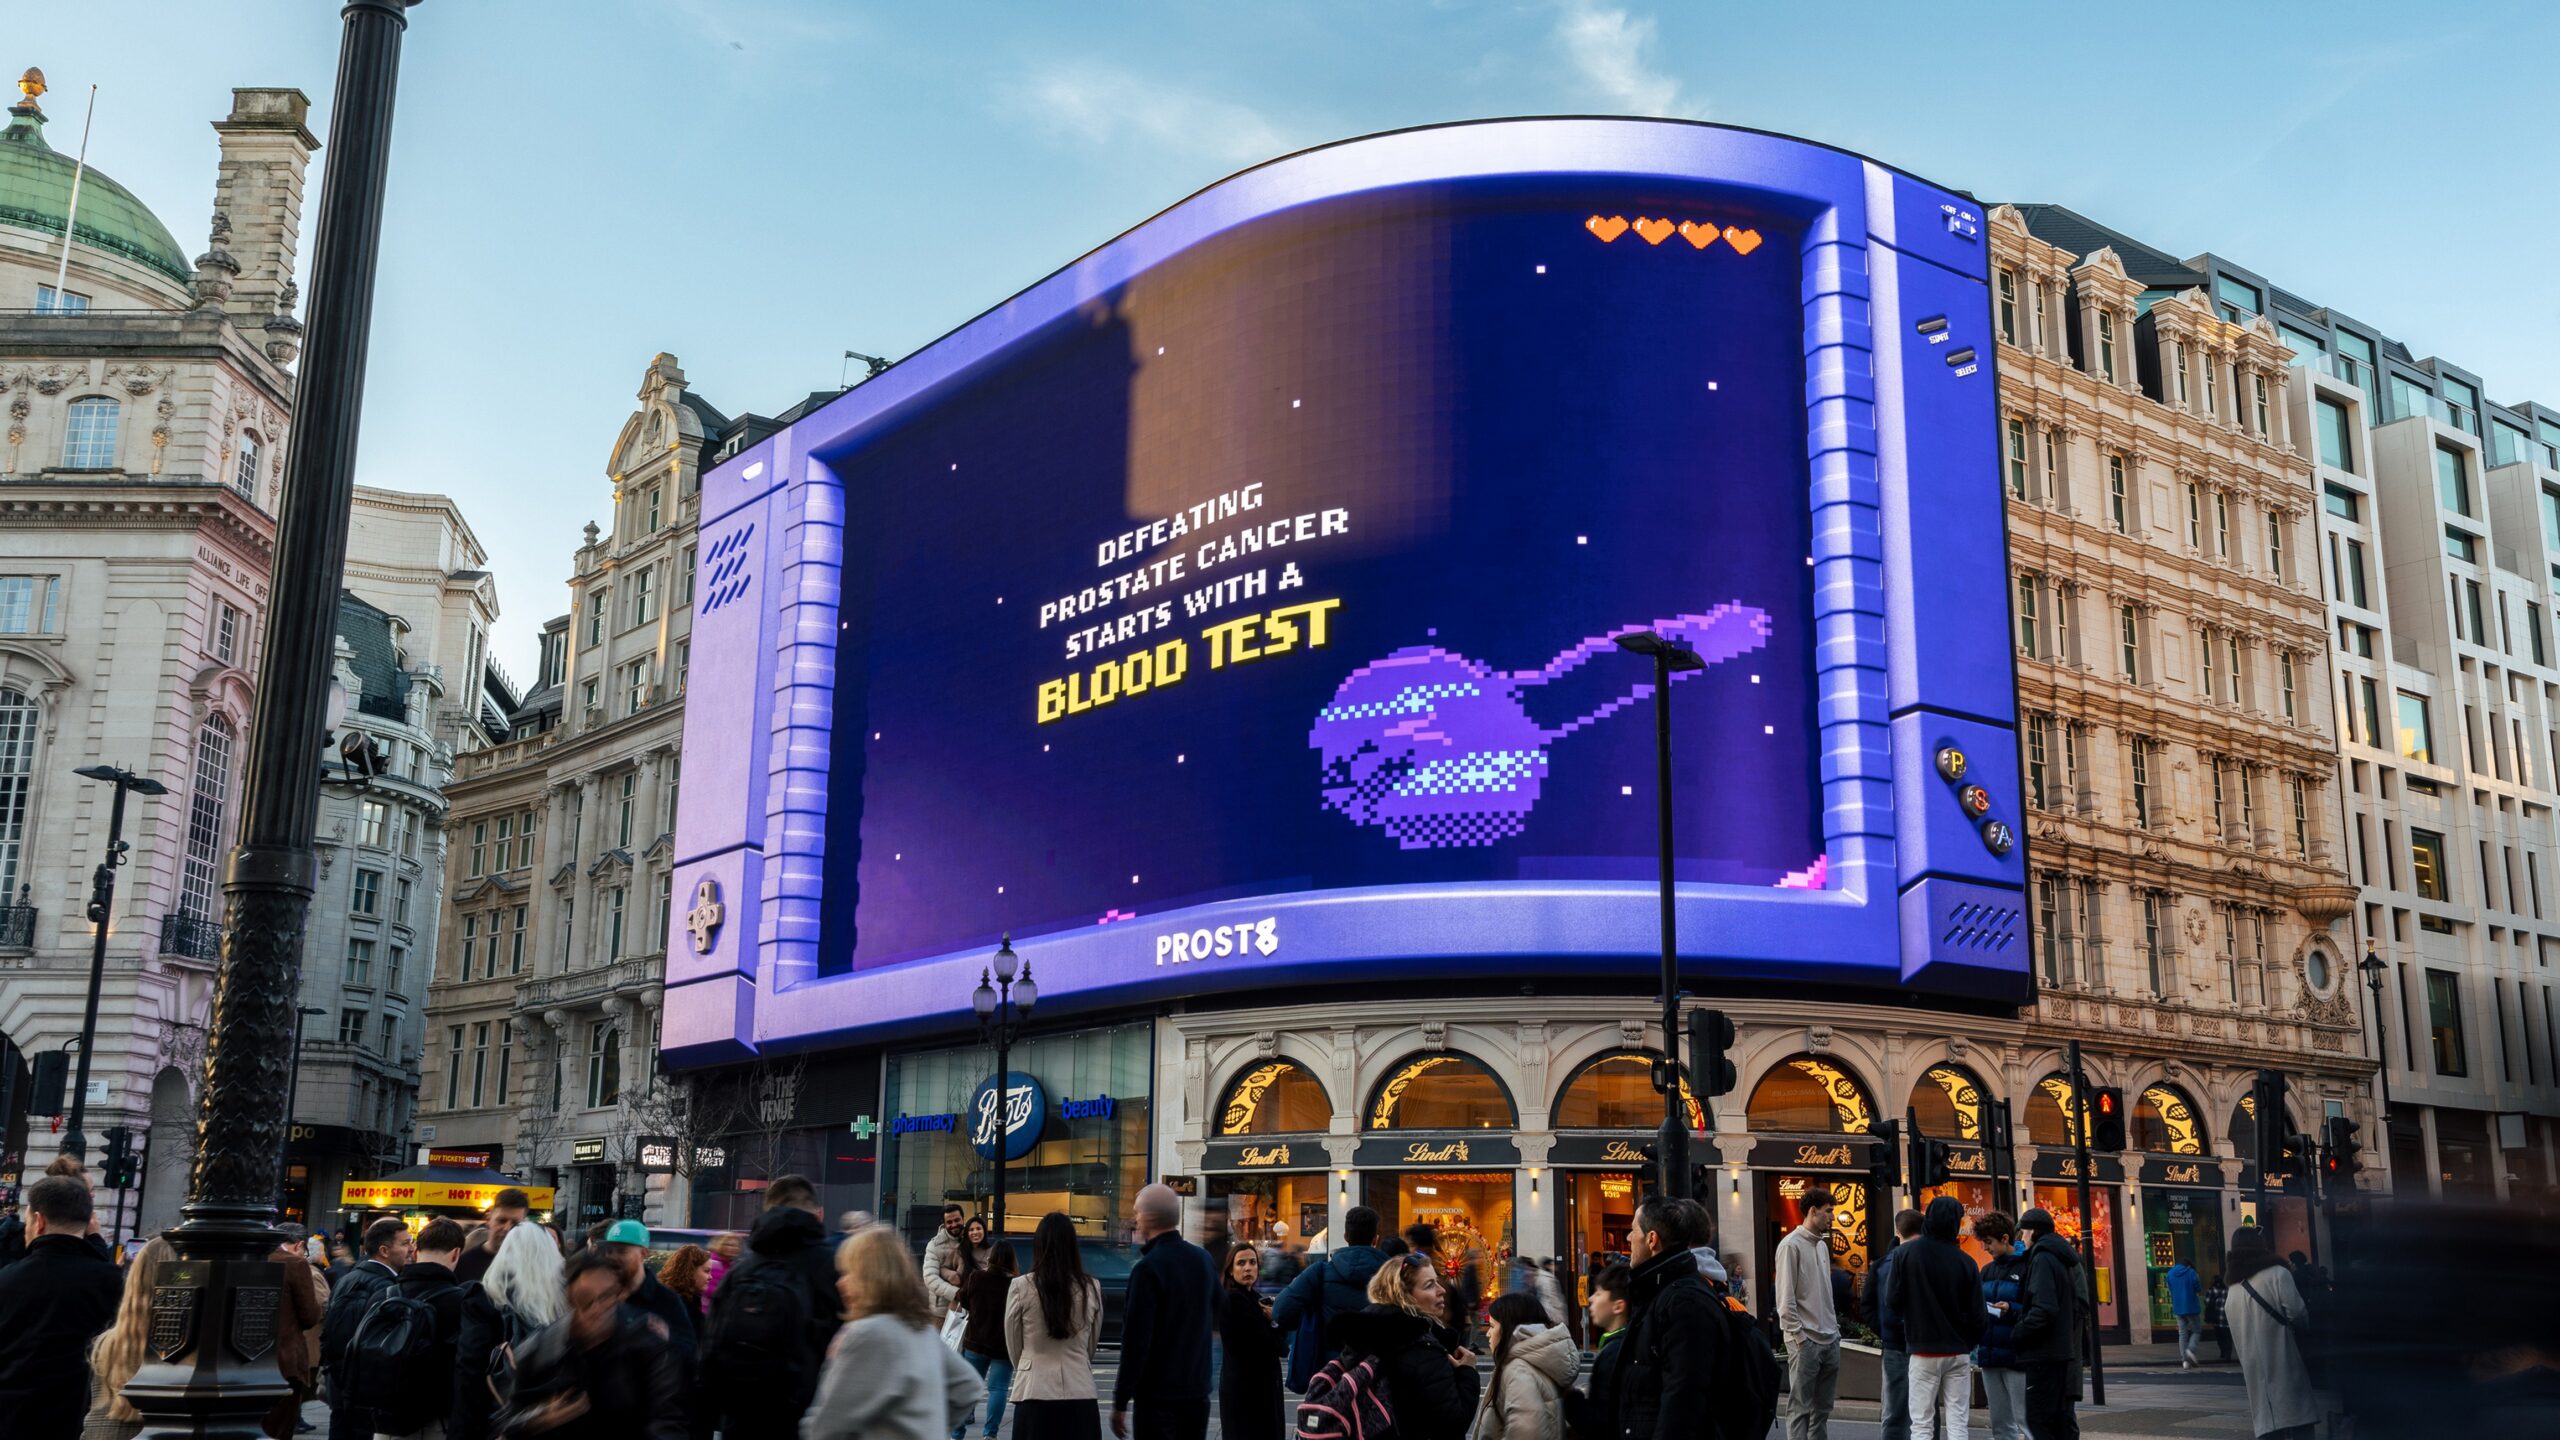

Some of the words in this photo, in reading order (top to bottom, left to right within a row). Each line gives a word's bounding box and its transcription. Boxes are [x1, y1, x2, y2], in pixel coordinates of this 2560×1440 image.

[1928, 331, 1949, 344] START
[1955, 363, 1978, 378] SELECT
[1097, 482, 1263, 567] DEFEATING
[197, 545, 231, 577] ALLIANCE
[236, 570, 250, 590] LIFE
[255, 583, 268, 600] OFF
[1039, 552, 1186, 629] PROSTATE
[1197, 507, 1349, 570] CANCER
[1065, 600, 1172, 660] STARTS
[1183, 568, 1267, 618] WITH
[1278, 562, 1303, 590] A
[1037, 638, 1188, 725] BLOOD
[1202, 598, 1341, 670] TEST
[1951, 751, 1964, 772] P
[1975, 789, 1988, 810] S
[1997, 825, 2013, 846] A
[160, 965, 184, 979] COUNTY
[775, 1075, 796, 1099] THE
[760, 1097, 795, 1122] VENUE
[972, 1085, 1033, 1146] Bots
[1062, 1095, 1114, 1121] beauty
[282, 1125, 316, 1142] po
[892, 1113, 956, 1138] pharmacy
[642, 1155, 671, 1166] VENUE
[654, 1146, 672, 1156] THE
[1237, 1146, 1280, 1166] Lindt
[1402, 1142, 1457, 1162] Lindt
[1601, 1141, 1648, 1161] Lin
[1794, 1145, 1841, 1165] Lindt
[1946, 1151, 1979, 1171] Lindt
[2060, 1159, 2077, 1176] Lin
[2164, 1165, 2193, 1183] Lindt
[347, 1188, 367, 1198] HOT
[368, 1188, 388, 1198] DOG
[390, 1188, 415, 1198] SPOT
[448, 1189, 472, 1200] HOT
[1779, 1179, 1805, 1190] Lindt
[1961, 1203, 1985, 1216] Easter
